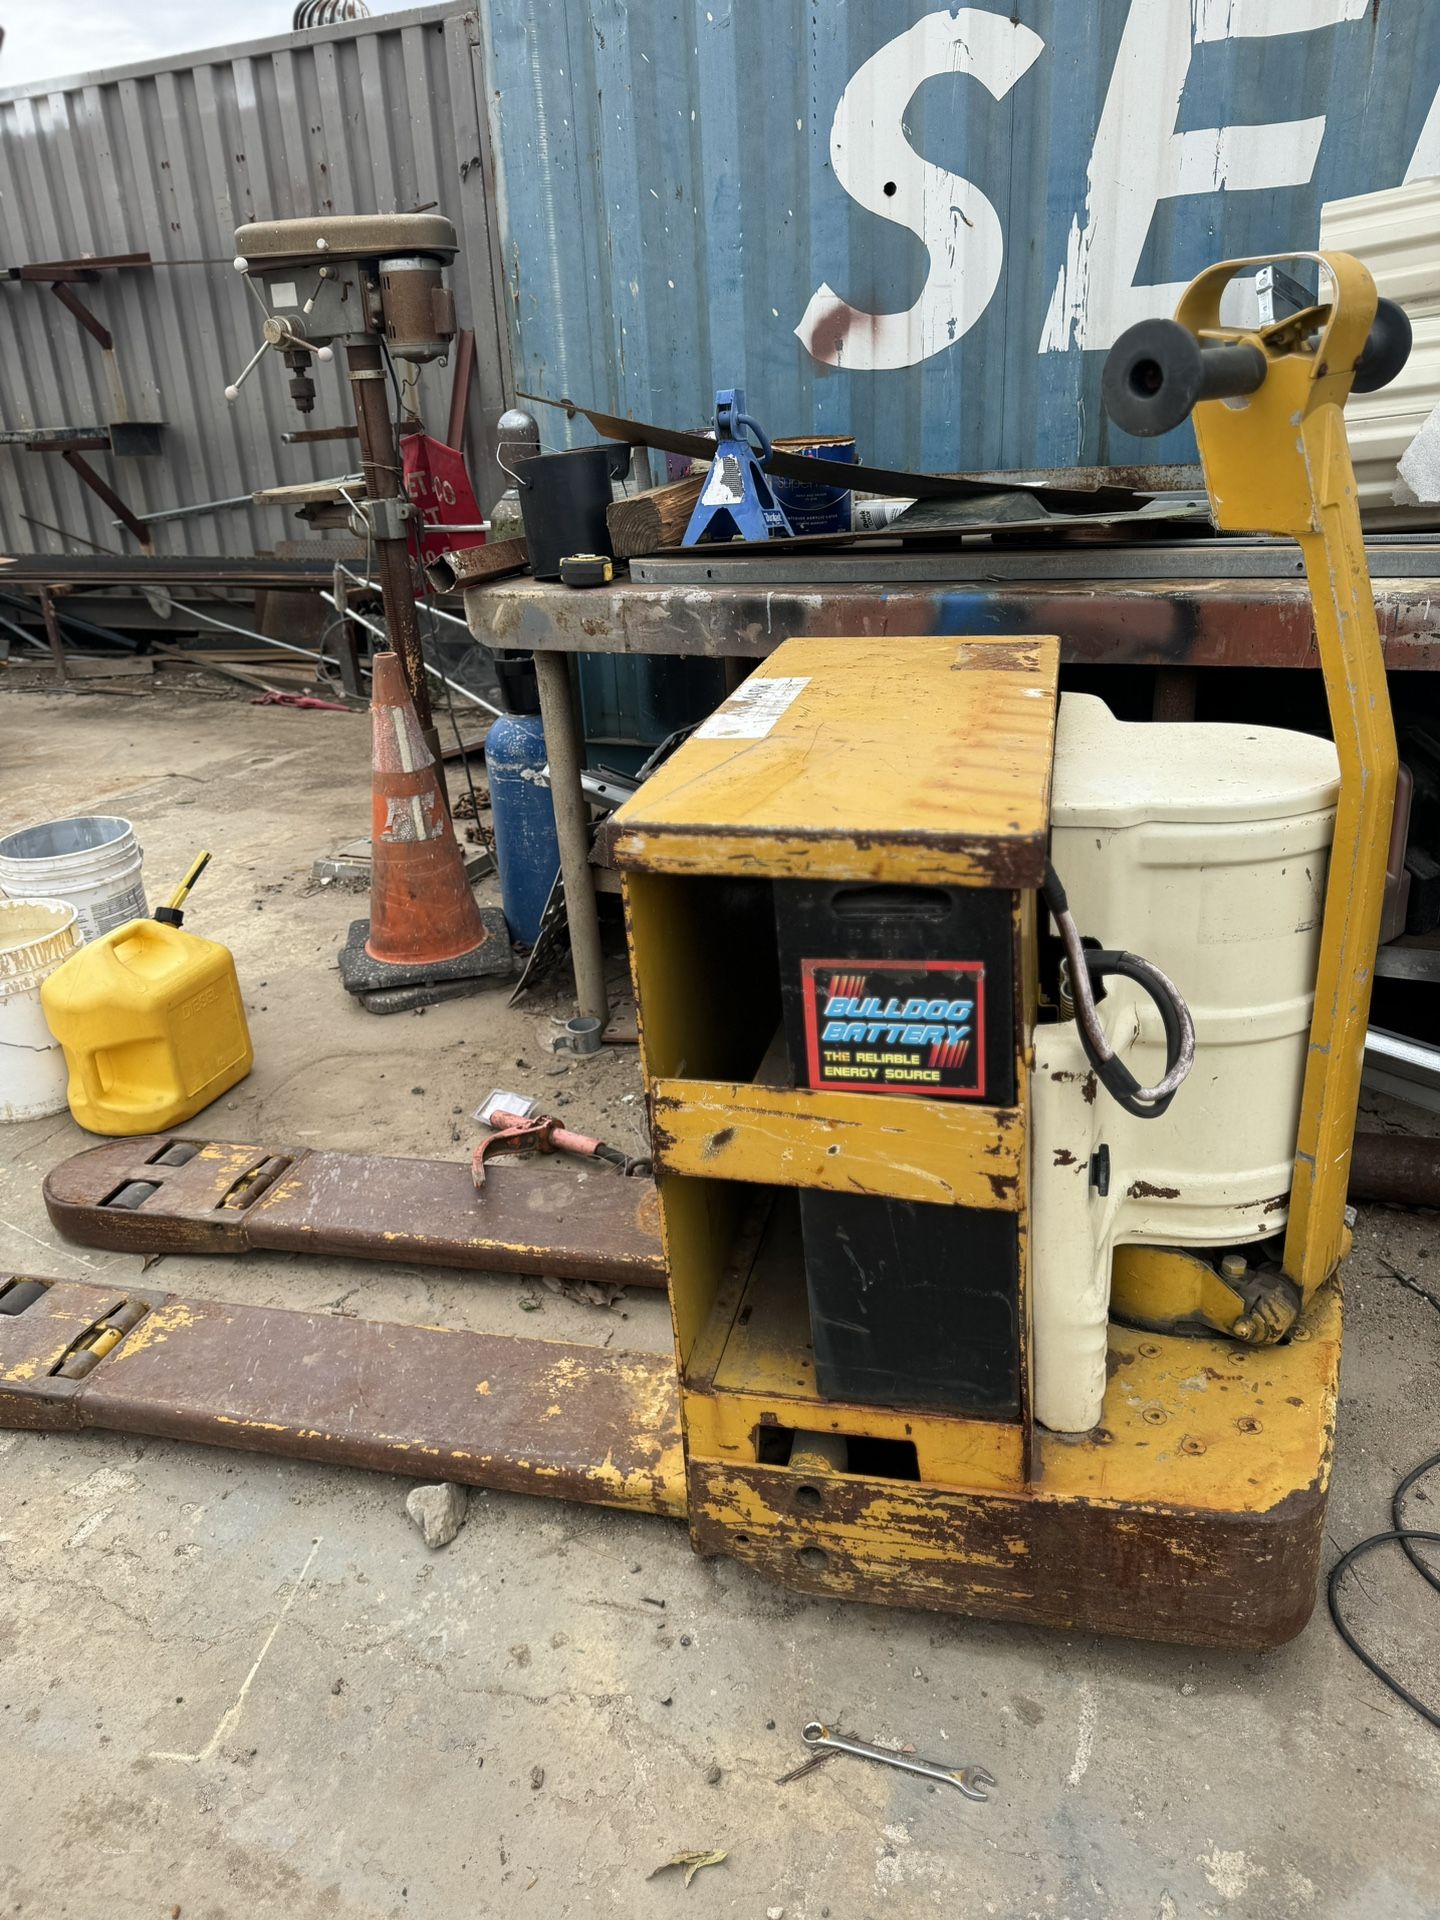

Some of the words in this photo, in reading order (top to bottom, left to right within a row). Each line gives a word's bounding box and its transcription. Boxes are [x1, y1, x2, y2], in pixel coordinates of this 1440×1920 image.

[795, 0, 1440, 371] SE
[823, 996, 975, 1021] BULLDOG
[821, 1021, 971, 1046] BATTERY
[824, 1051, 850, 1062] THE
[856, 1052, 920, 1065] RELIABLE
[824, 1066, 879, 1078] ENERGY
[885, 1068, 941, 1081] SOURCE
